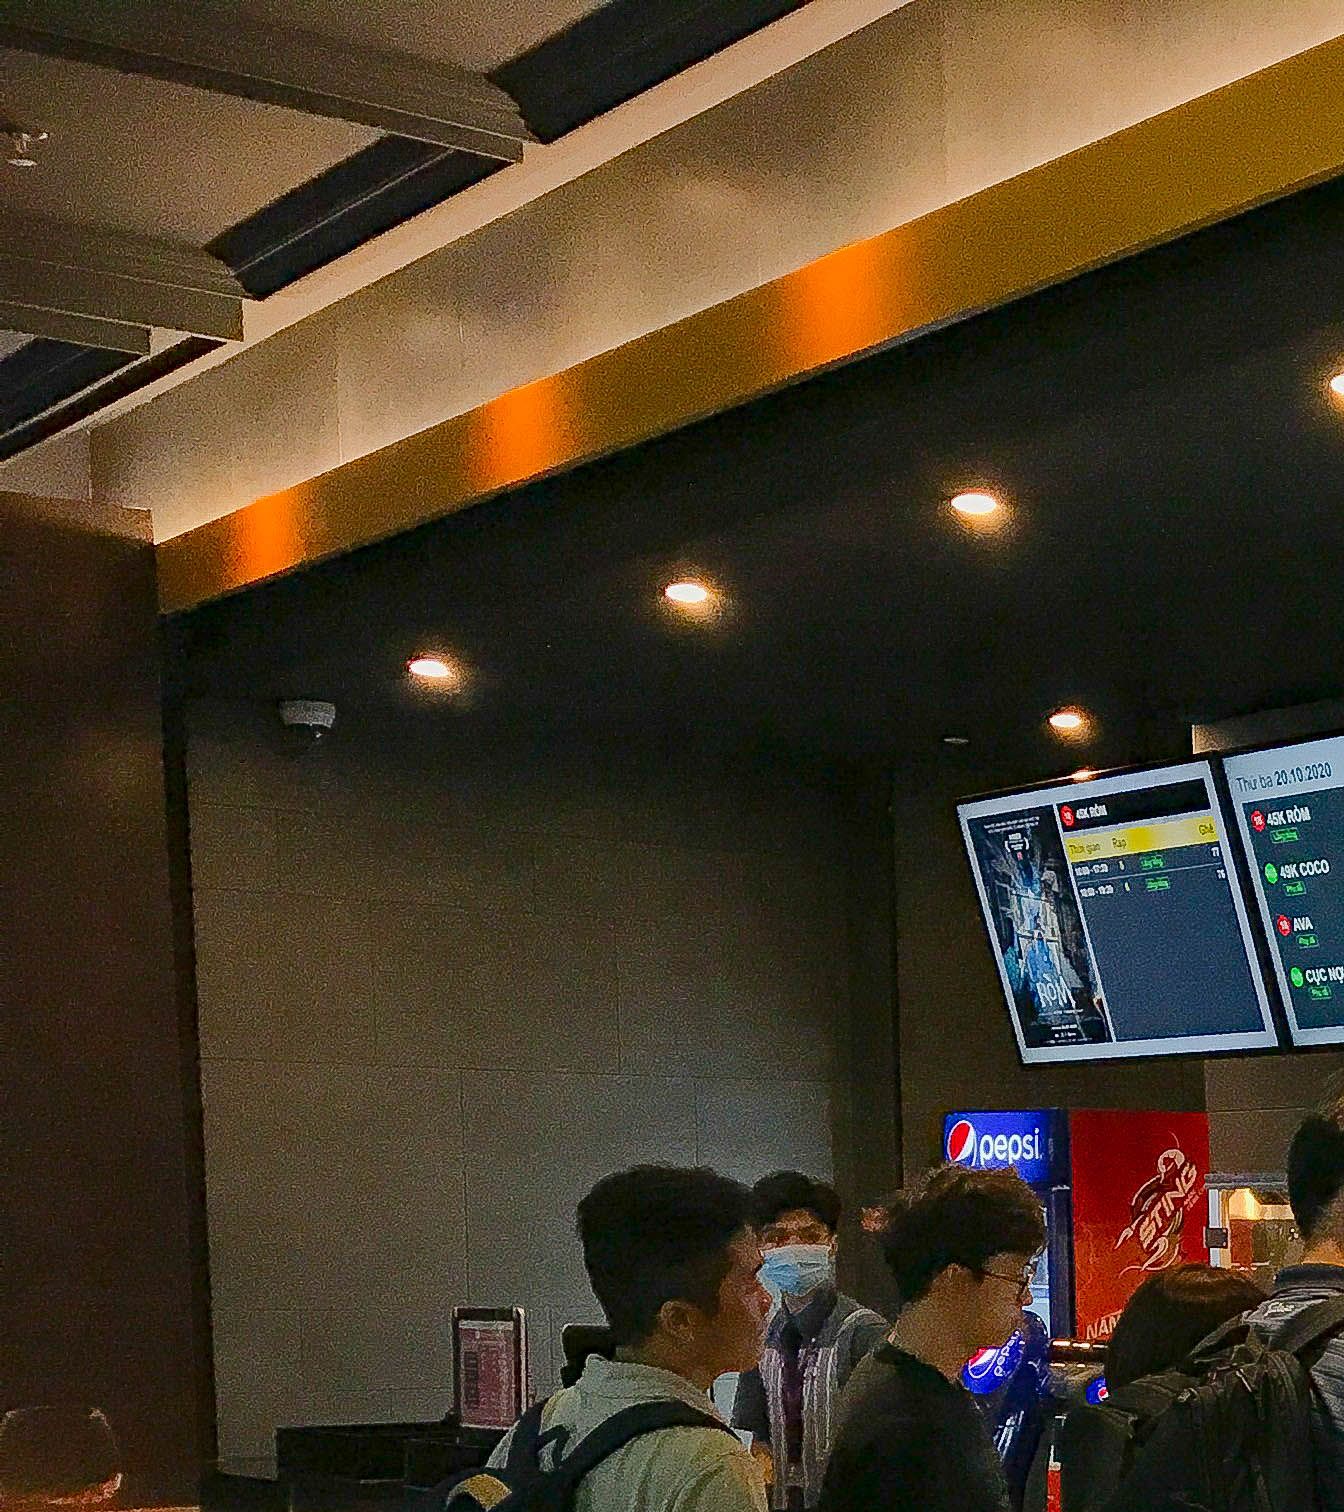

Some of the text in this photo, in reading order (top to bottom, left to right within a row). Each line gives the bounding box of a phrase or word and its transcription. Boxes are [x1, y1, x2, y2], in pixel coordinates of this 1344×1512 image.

[1274, 762, 1332, 786] 20.10.2020
[1299, 859, 1330, 877] COCO
[1293, 917, 1313, 932] AVA
[979, 1128, 1041, 1166] pepsi
[1139, 1163, 1197, 1251] STING
